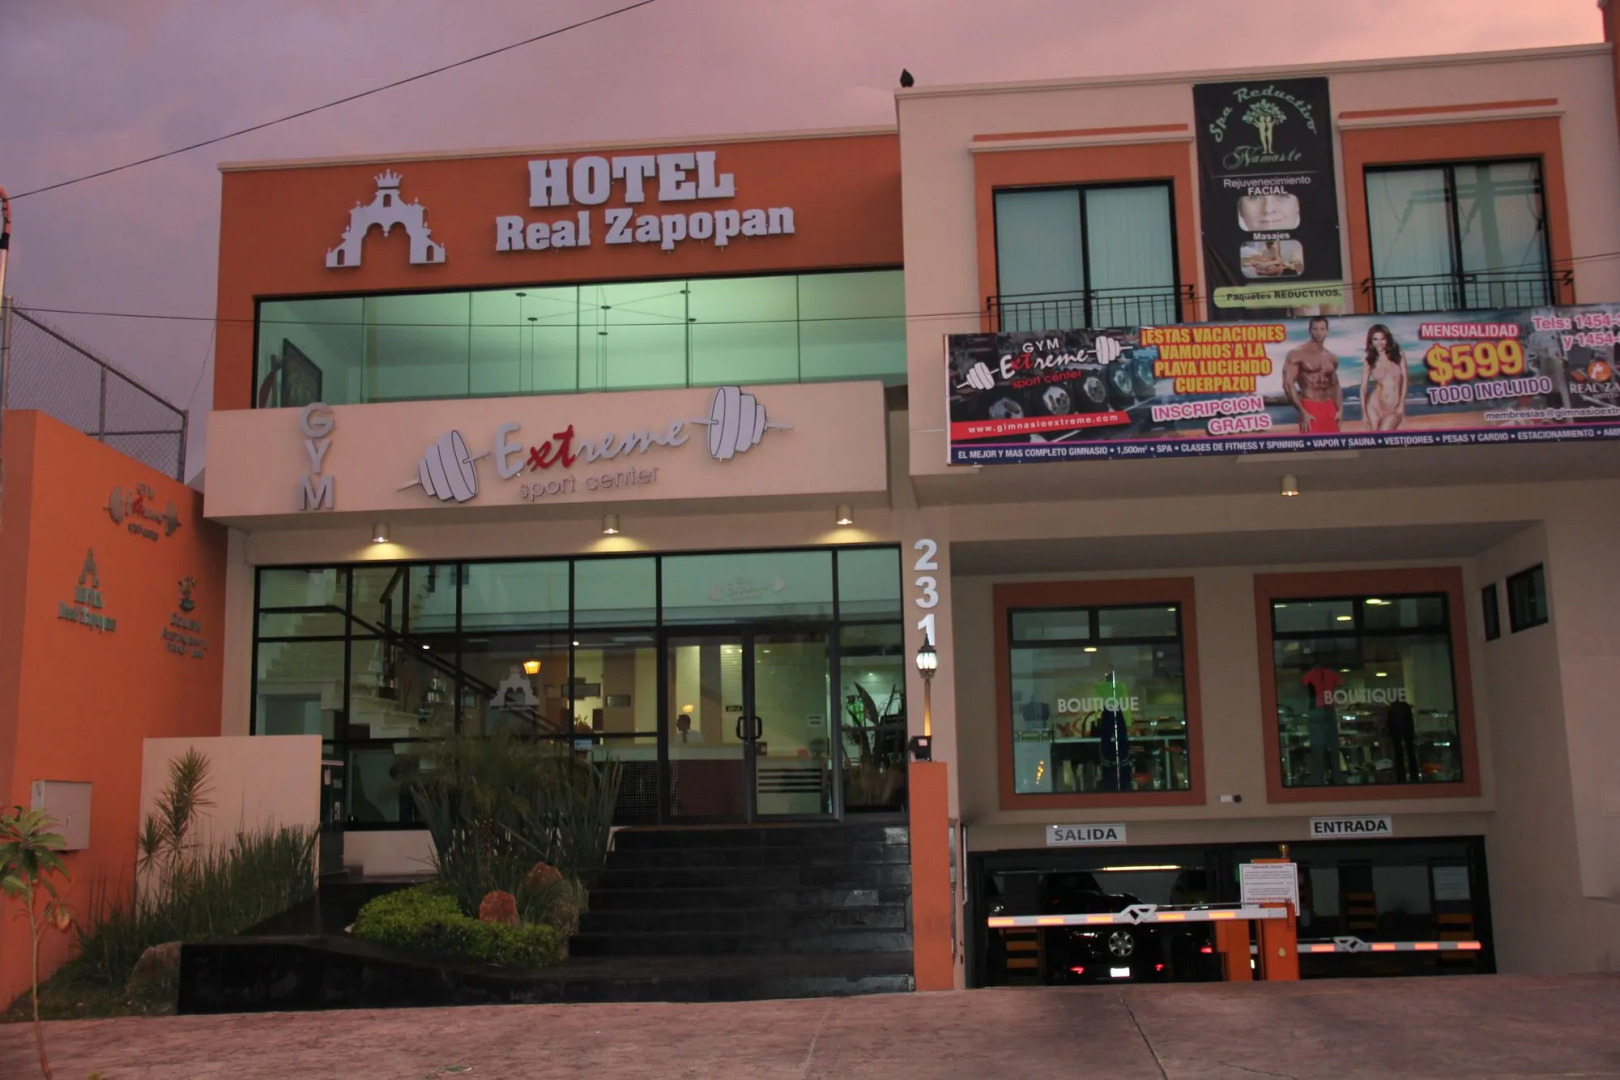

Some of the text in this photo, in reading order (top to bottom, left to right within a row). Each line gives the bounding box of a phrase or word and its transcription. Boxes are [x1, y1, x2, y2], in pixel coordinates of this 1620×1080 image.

[1209, 84, 1317, 143] Spa Reductivo
[1222, 145, 1302, 170] Namaste
[528, 151, 735, 207] HOTEL
[1223, 176, 1311, 189] Rejuvenecimiento
[1248, 186, 1288, 195] FACIAL
[496, 206, 795, 251] Real Zapopan
[1253, 232, 1291, 241] Masajes
[1227, 289, 1342, 302] Paquetes REDUCTIVOS.
[1421, 324, 1519, 338] MENSUALIDAD
[1534, 316, 1572, 330] Tels:
[1192, 325, 1285, 342] VACACIONES
[1022, 338, 1060, 353] GYM
[1159, 343, 1266, 360] VAMONOS A LA
[1563, 336, 1573, 350] y
[1000, 350, 1088, 380] Extreme
[1154, 359, 1271, 377] PLAYA LUCIENDO
[1427, 340, 1523, 385] $599
[1011, 370, 1082, 389] sport center
[1175, 376, 1256, 393] CUERPAZO!
[1570, 383, 1599, 393] REAL
[1429, 378, 1551, 403] TODO INCLUIDO
[1153, 398, 1263, 420] INSCRIPCION
[968, 414, 1118, 434] www.gimnasioextreme.com
[1209, 415, 1271, 433] GRATIS
[496, 418, 690, 480] Extreme
[958, 451, 967, 459] EL
[969, 450, 996, 459] MEJOR
[999, 450, 1004, 458] Y
[1005, 449, 1023, 458] MAS
[1025, 448, 1067, 457] COMPLETO
[1069, 446, 1108, 456] GIMNASIO
[1157, 445, 1173, 453] SPA
[1181, 443, 1211, 452] CLASES
[1213, 442, 1223, 451] DE
[1225, 441, 1258, 450] FITNESS
[1259, 441, 1265, 449] Y
[1266, 439, 1304, 449] SPINNING
[1312, 438, 1339, 448] VAPOR
[1340, 438, 1346, 446] Y
[1348, 436, 1375, 447] SAUNA
[1384, 435, 1433, 445] VESTIDORES
[1442, 434, 1468, 444] PESAS
[1470, 434, 1476, 442] Y
[1478, 432, 1508, 442] CARDIO
[1518, 429, 1594, 440] ESTACIONAMIENTO
[299, 402, 336, 510] GYM
[519, 466, 660, 500] sport center
[1323, 688, 1408, 704] BOUTIQUE
[1057, 697, 1139, 713] BOUTIQUE
[1054, 828, 1118, 841] SALIDA
[1314, 820, 1388, 833] ENTRADA
